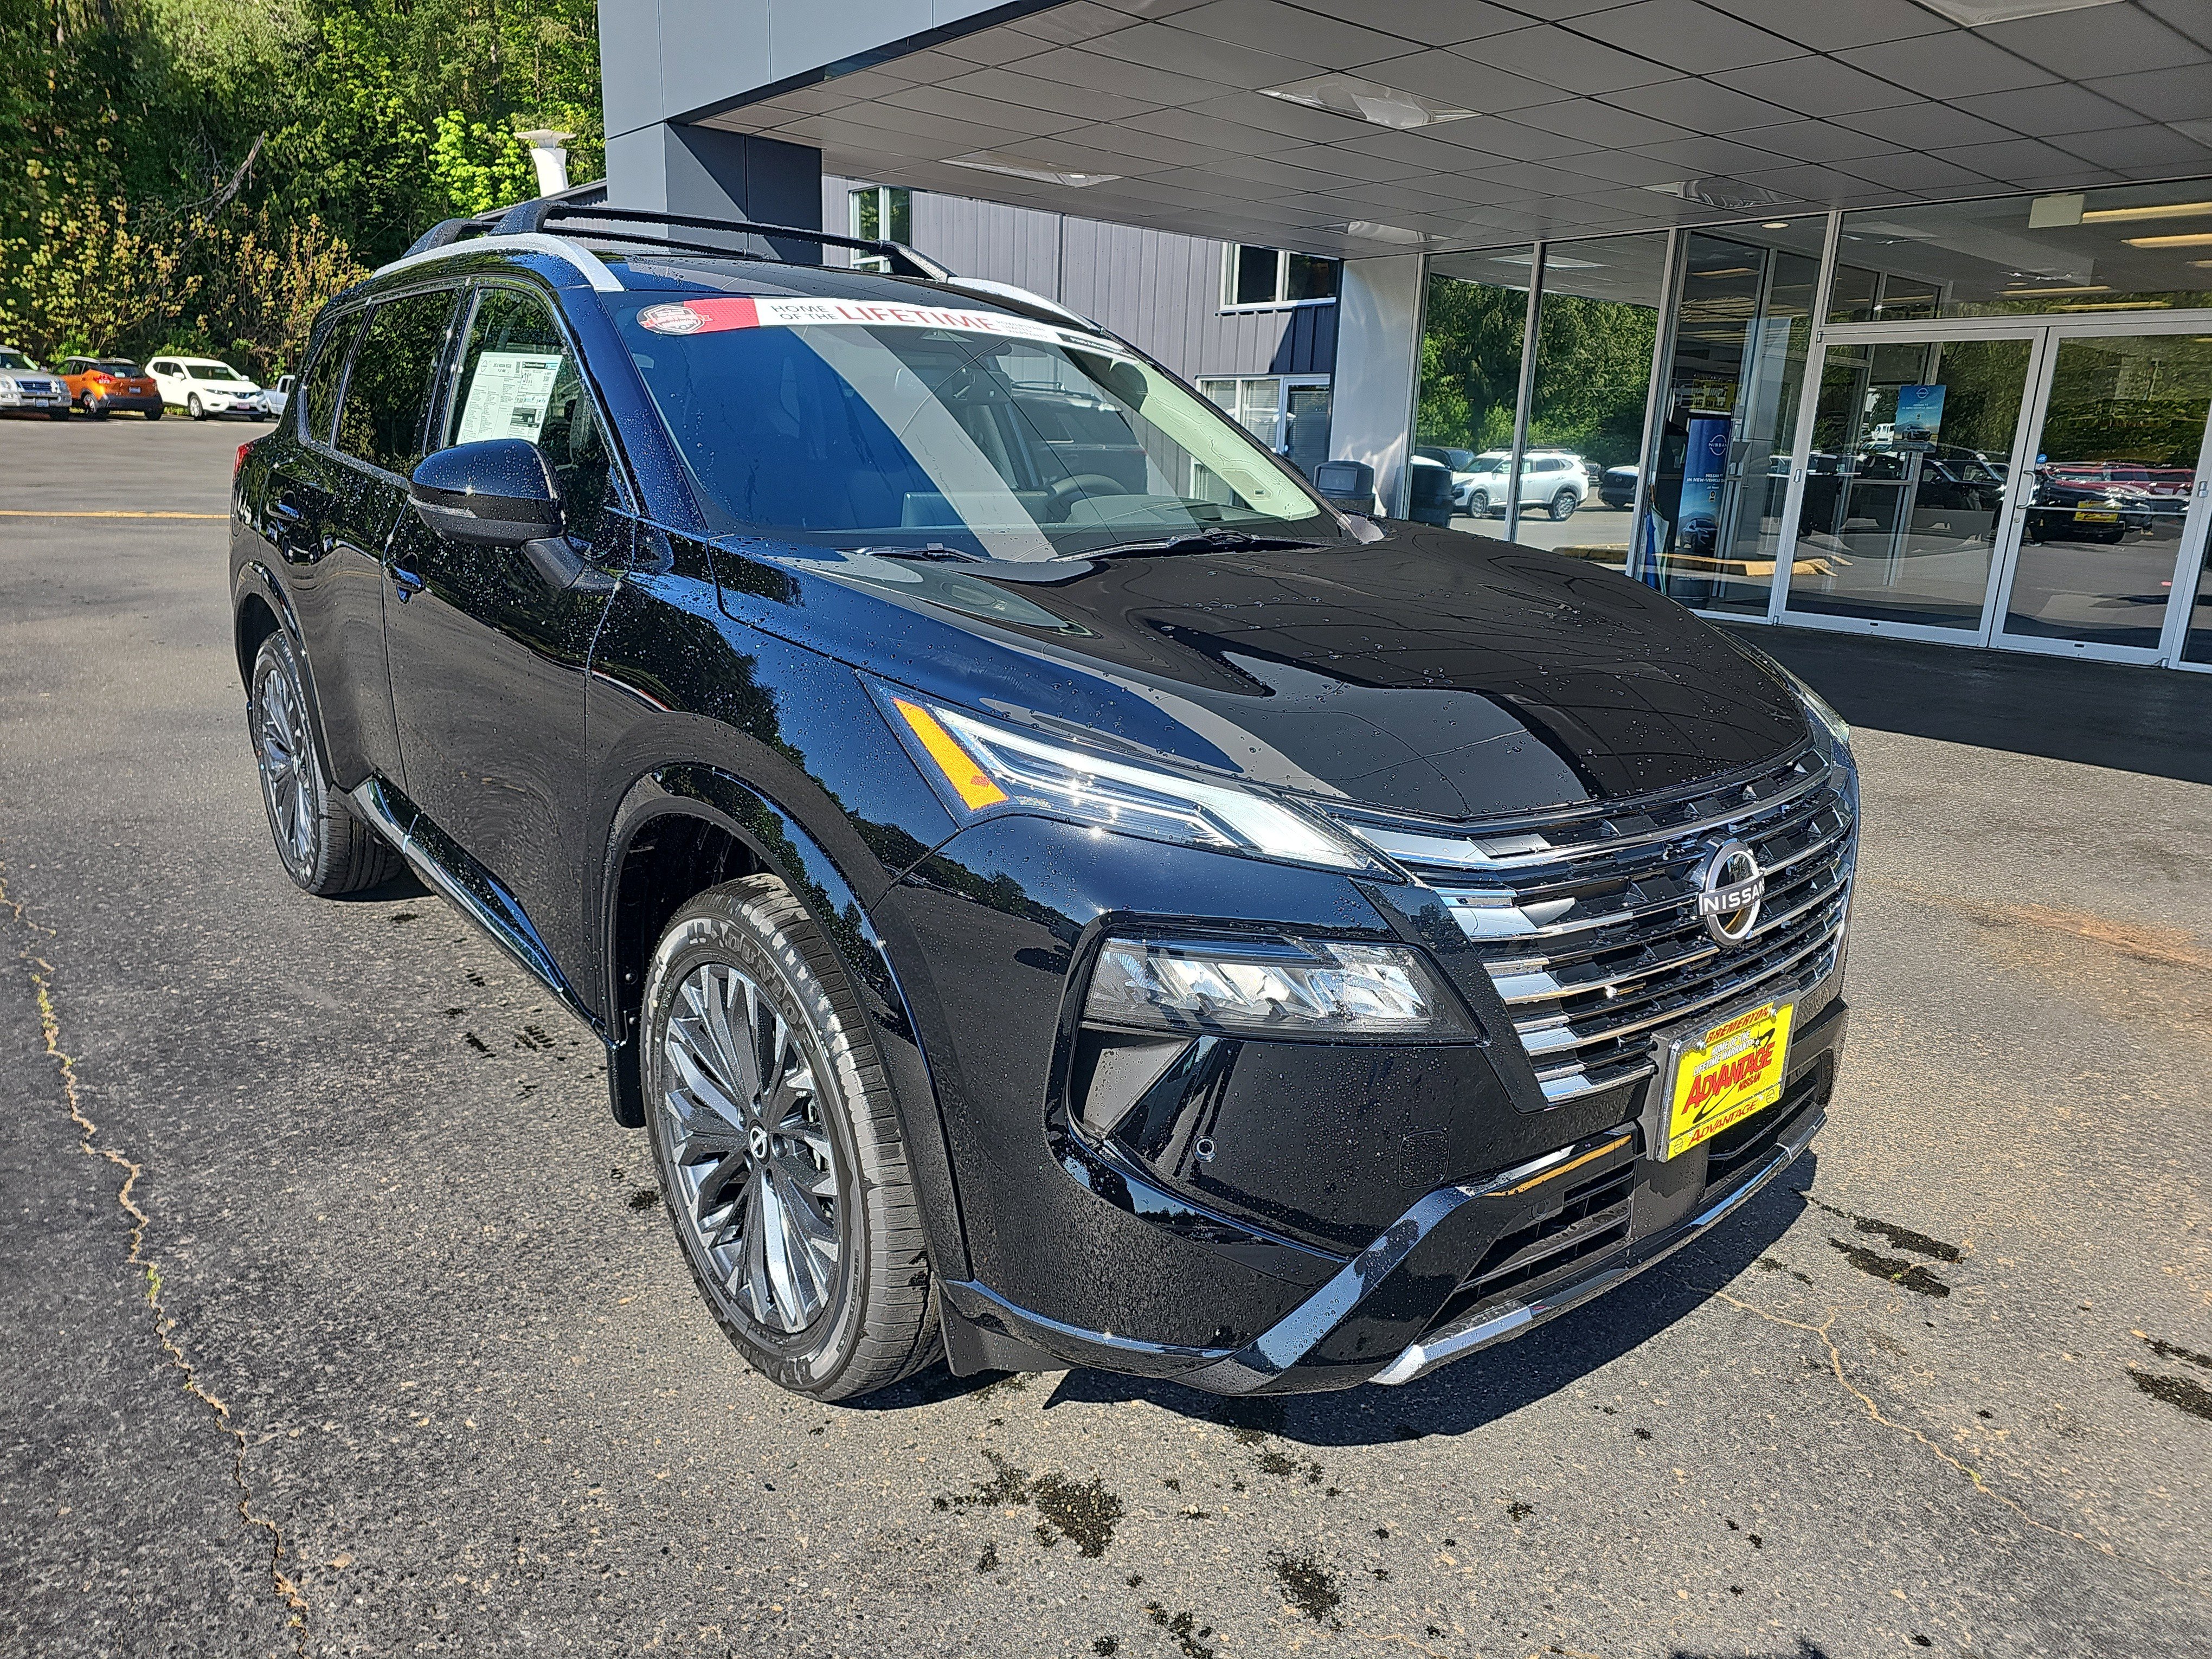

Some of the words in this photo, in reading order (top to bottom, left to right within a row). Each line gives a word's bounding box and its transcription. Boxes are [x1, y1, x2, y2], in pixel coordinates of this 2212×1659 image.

[834, 306, 1002, 332] LIFETIME
[1704, 878, 1765, 912] NISSAN
[724, 932, 815, 1054] DUNLOP
[1693, 1055, 1721, 1076] LIFETIME
[1721, 1038, 1754, 1061] WARRANTY
[1712, 1044, 1728, 1057] HOME
[1729, 1036, 1739, 1047] OF
[1739, 1030, 1751, 1043] THE
[1681, 1040, 1776, 1115] ADVANTAGE
[1687, 1101, 1758, 1147] ADVANTAGE
